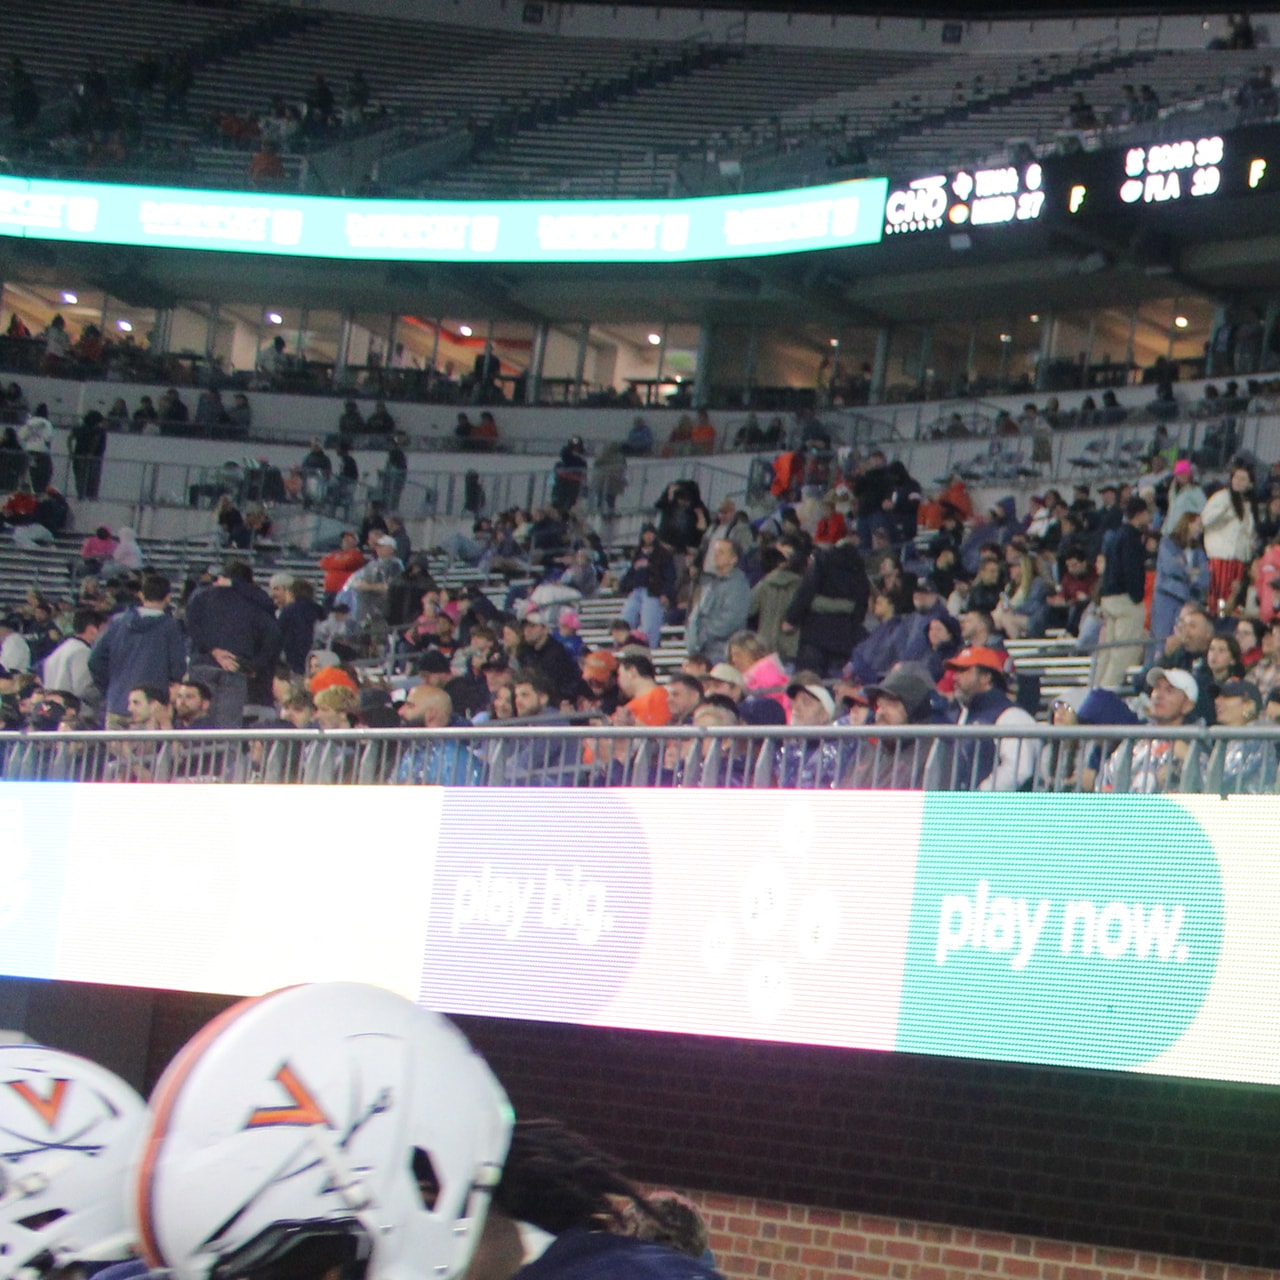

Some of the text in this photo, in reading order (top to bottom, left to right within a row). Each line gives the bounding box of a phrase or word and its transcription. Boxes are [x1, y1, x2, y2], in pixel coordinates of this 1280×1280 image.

[450, 863, 534, 938] play
[934, 881, 1189, 970] play now.
